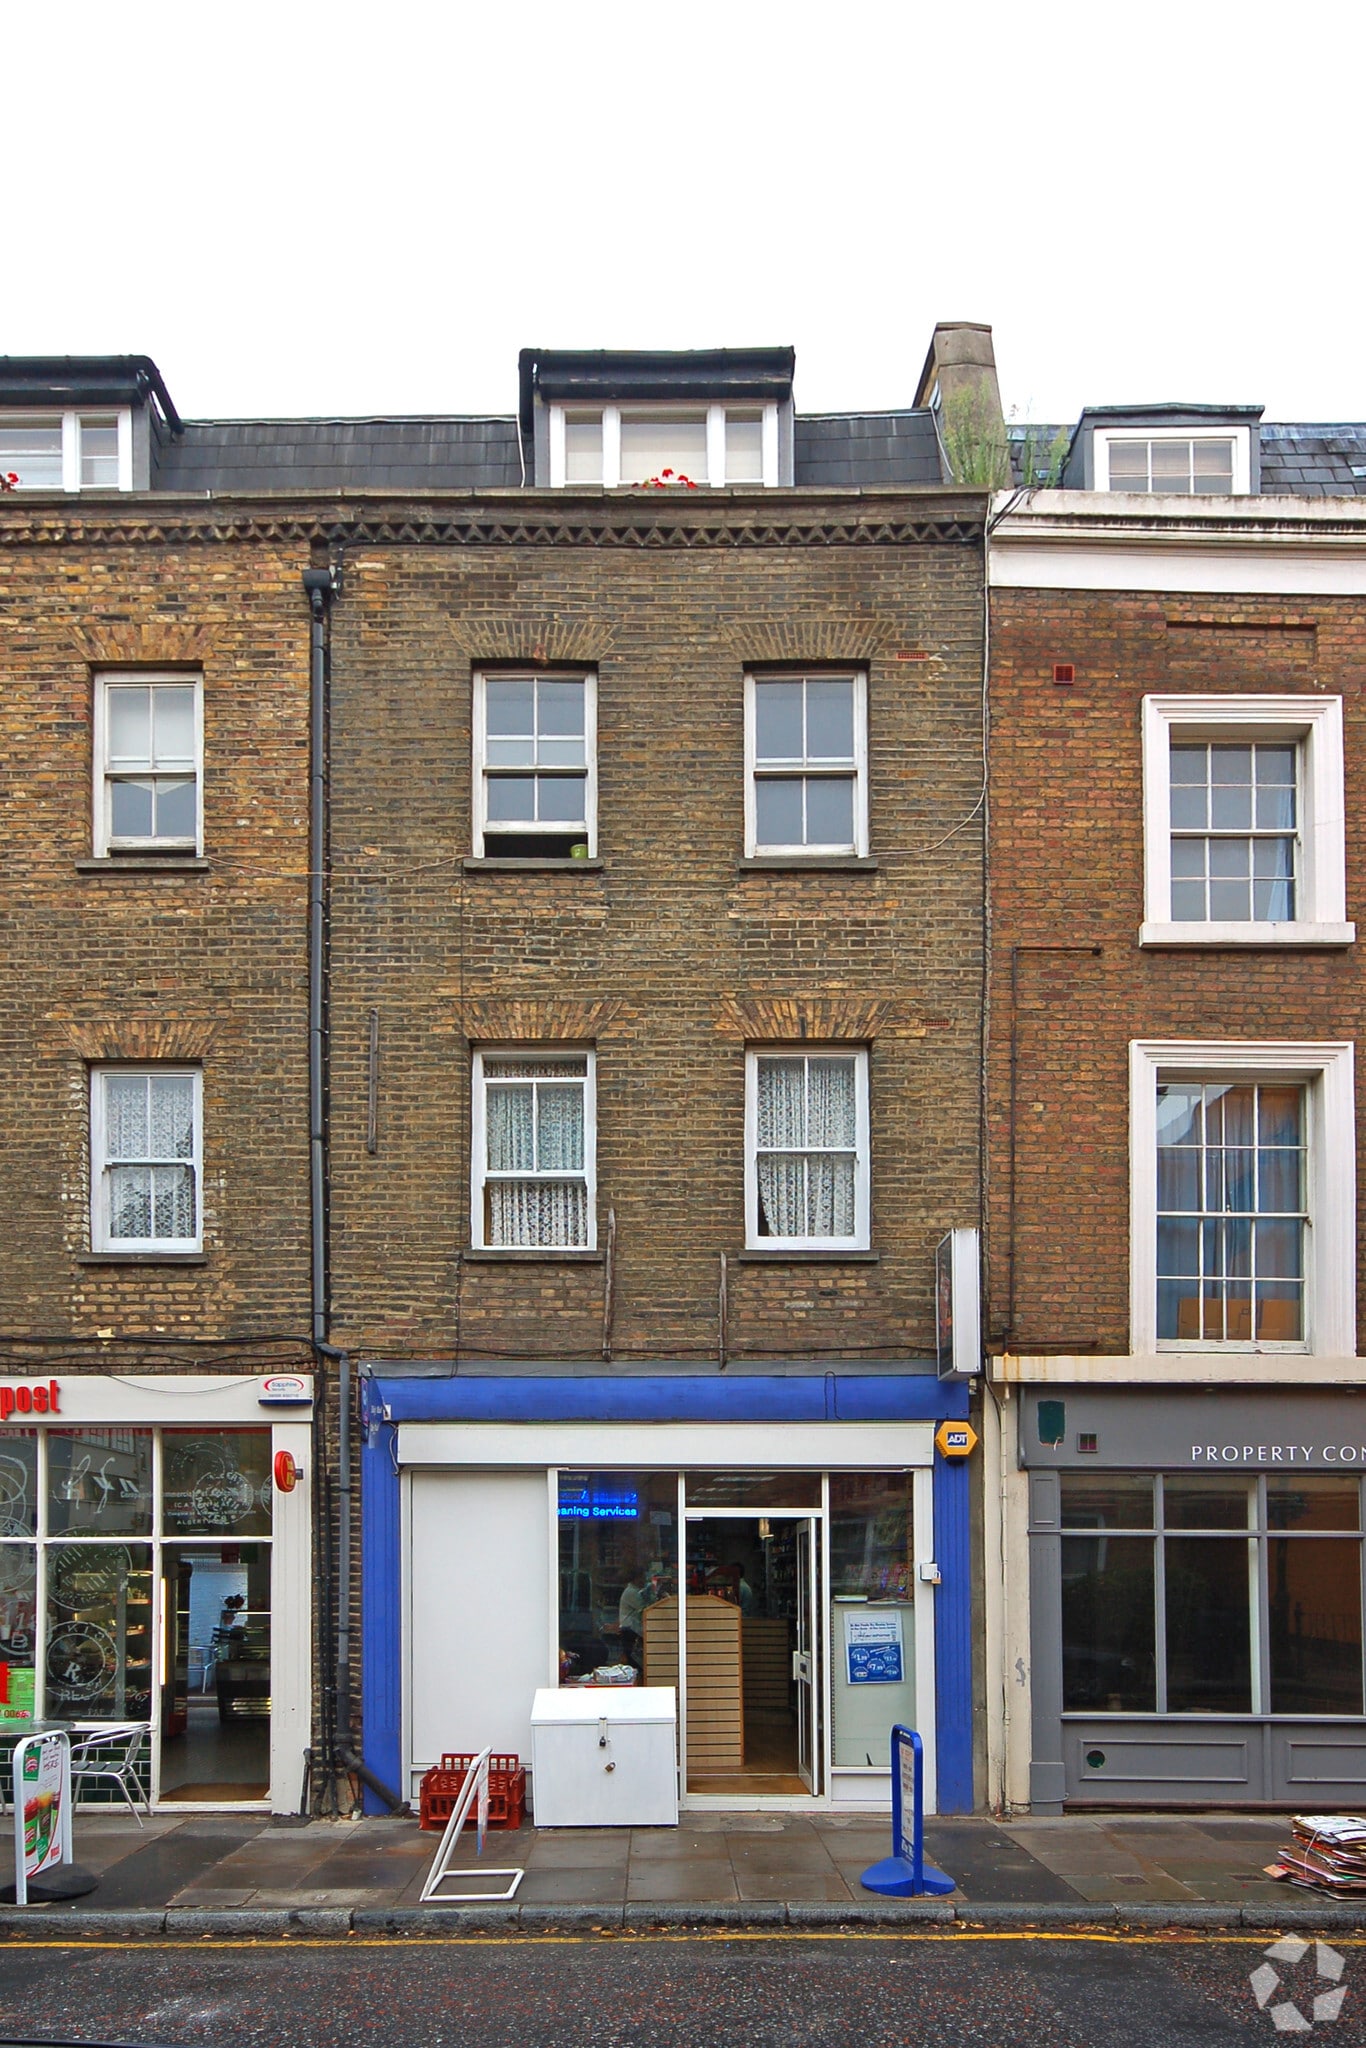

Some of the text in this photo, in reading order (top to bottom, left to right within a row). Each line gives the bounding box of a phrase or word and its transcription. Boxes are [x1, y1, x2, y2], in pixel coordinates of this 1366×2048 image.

[0, 1379, 62, 1420] post
[947, 1433, 968, 1444] ADT
[1191, 1445, 1313, 1462] PROPERTY
[592, 1505, 637, 1516] Services
